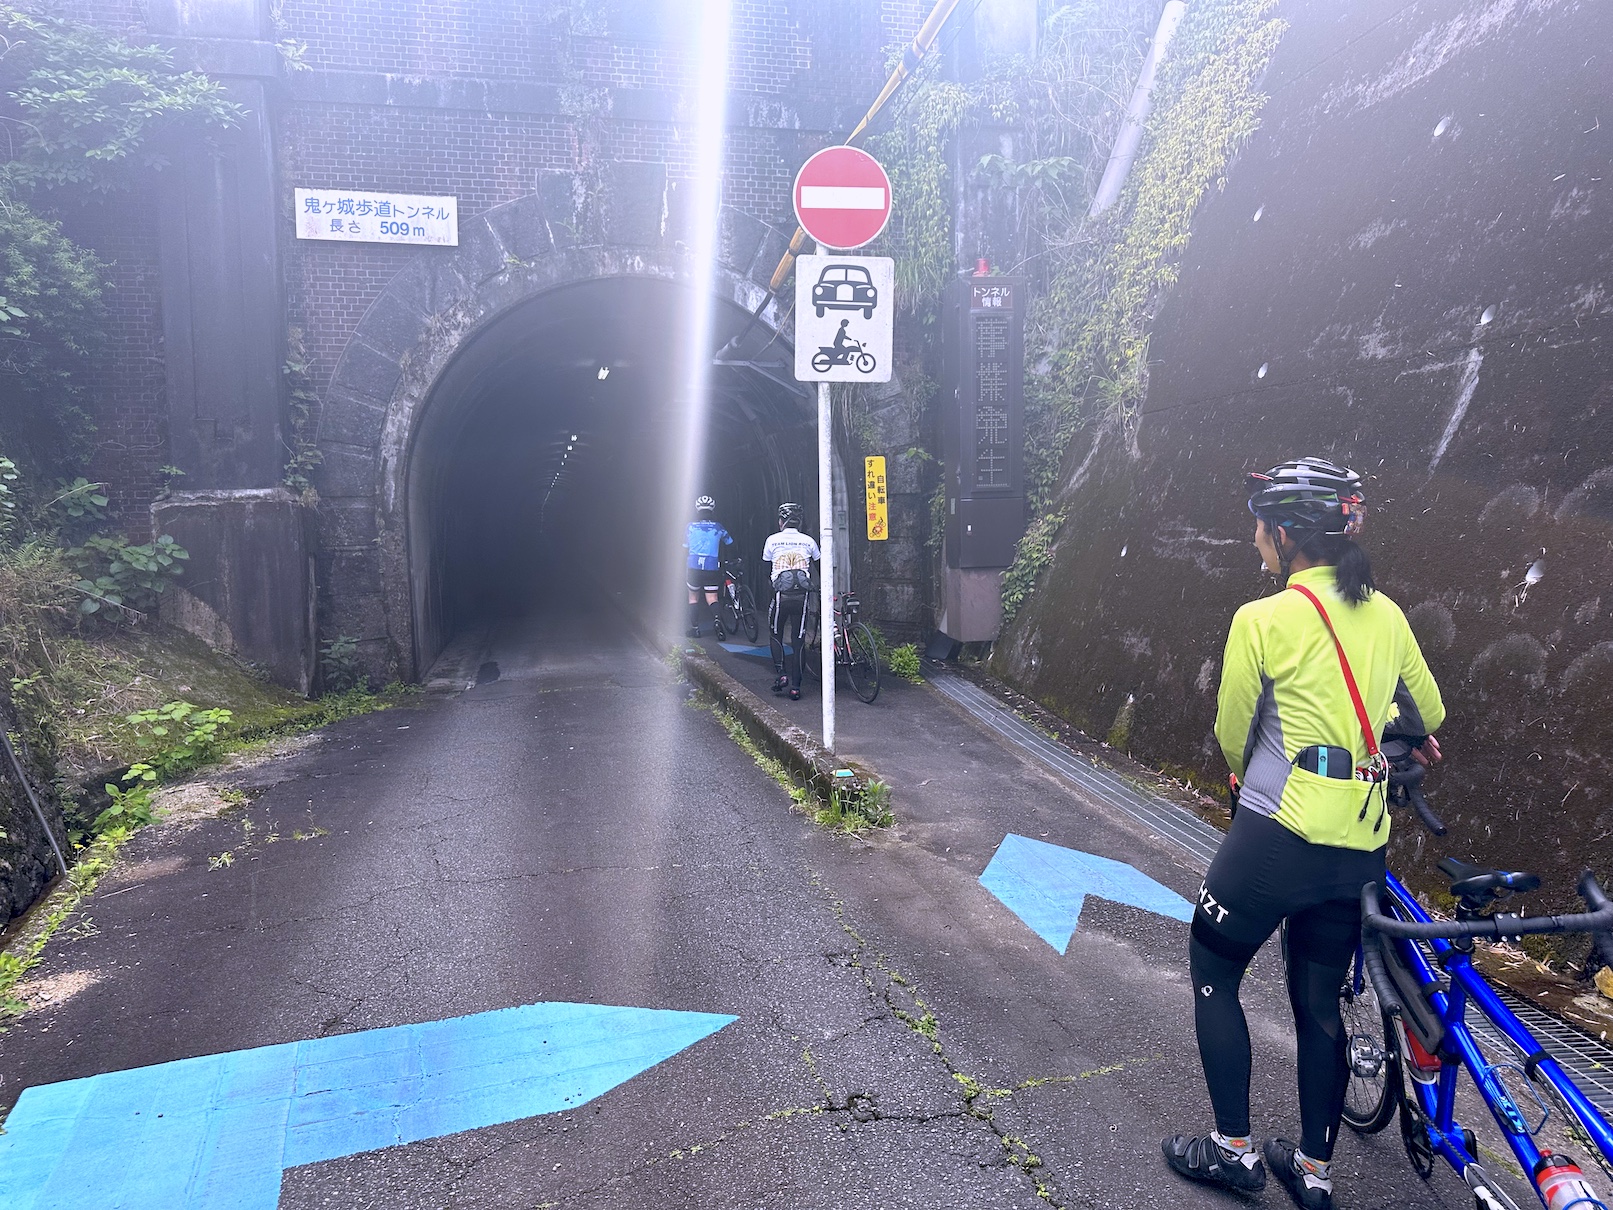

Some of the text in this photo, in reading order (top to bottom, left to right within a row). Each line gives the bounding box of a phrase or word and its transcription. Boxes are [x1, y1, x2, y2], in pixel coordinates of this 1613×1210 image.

[329, 218, 361, 234] 長さ
[973, 287, 1010, 297] トンネル
[981, 296, 1002, 307] 情報
[866, 459, 877, 521] すれ違い注意
[877, 475, 886, 505] 自転車
